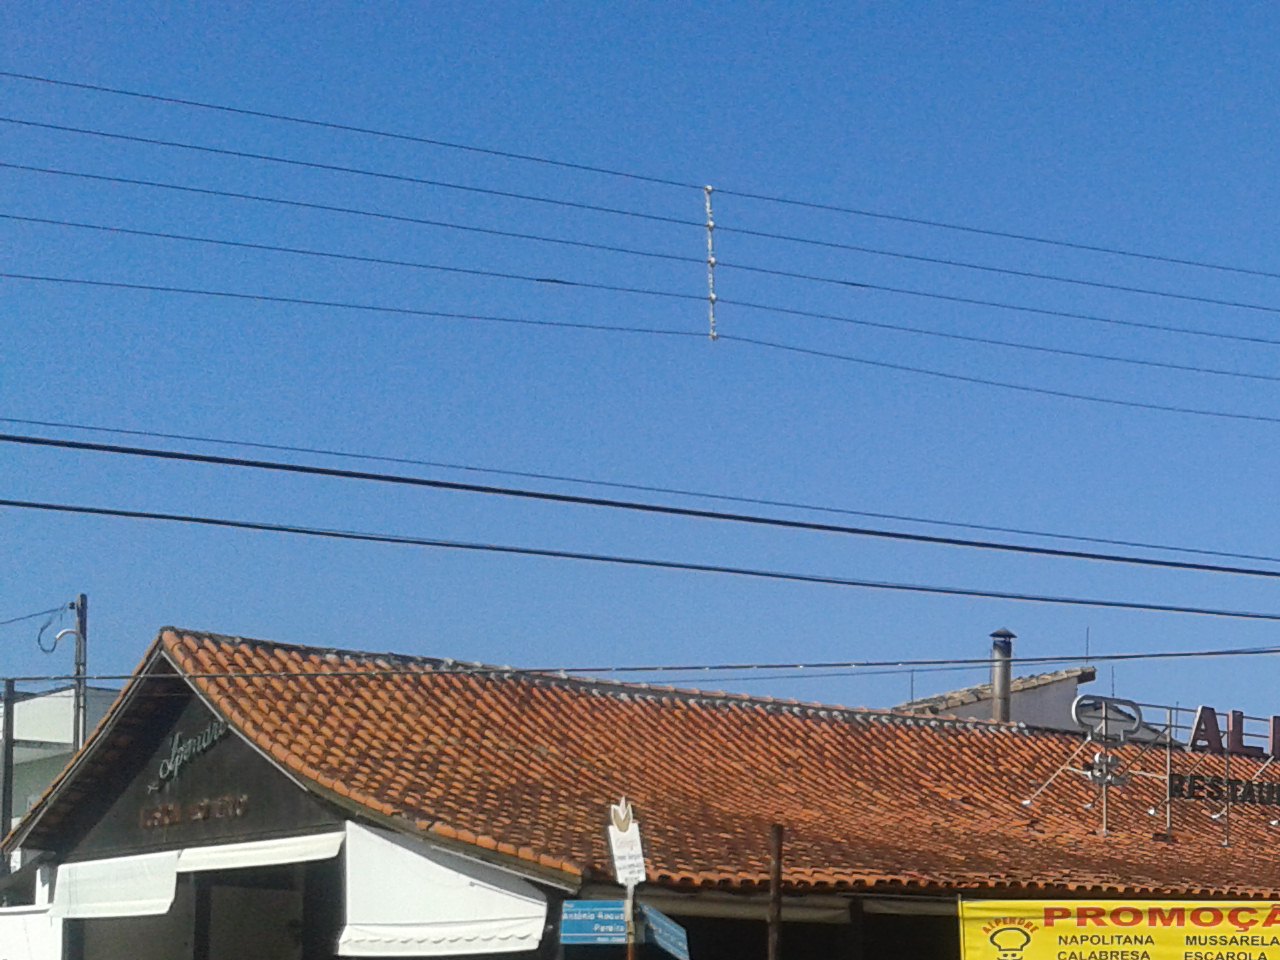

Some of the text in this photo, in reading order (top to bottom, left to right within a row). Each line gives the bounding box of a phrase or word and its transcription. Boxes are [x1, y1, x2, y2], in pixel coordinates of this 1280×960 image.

[982, 917, 1039, 935] ALPENDRE
[1058, 935, 1155, 946] NAPOLITANA
[1185, 935, 1280, 947] MUSSARELA
